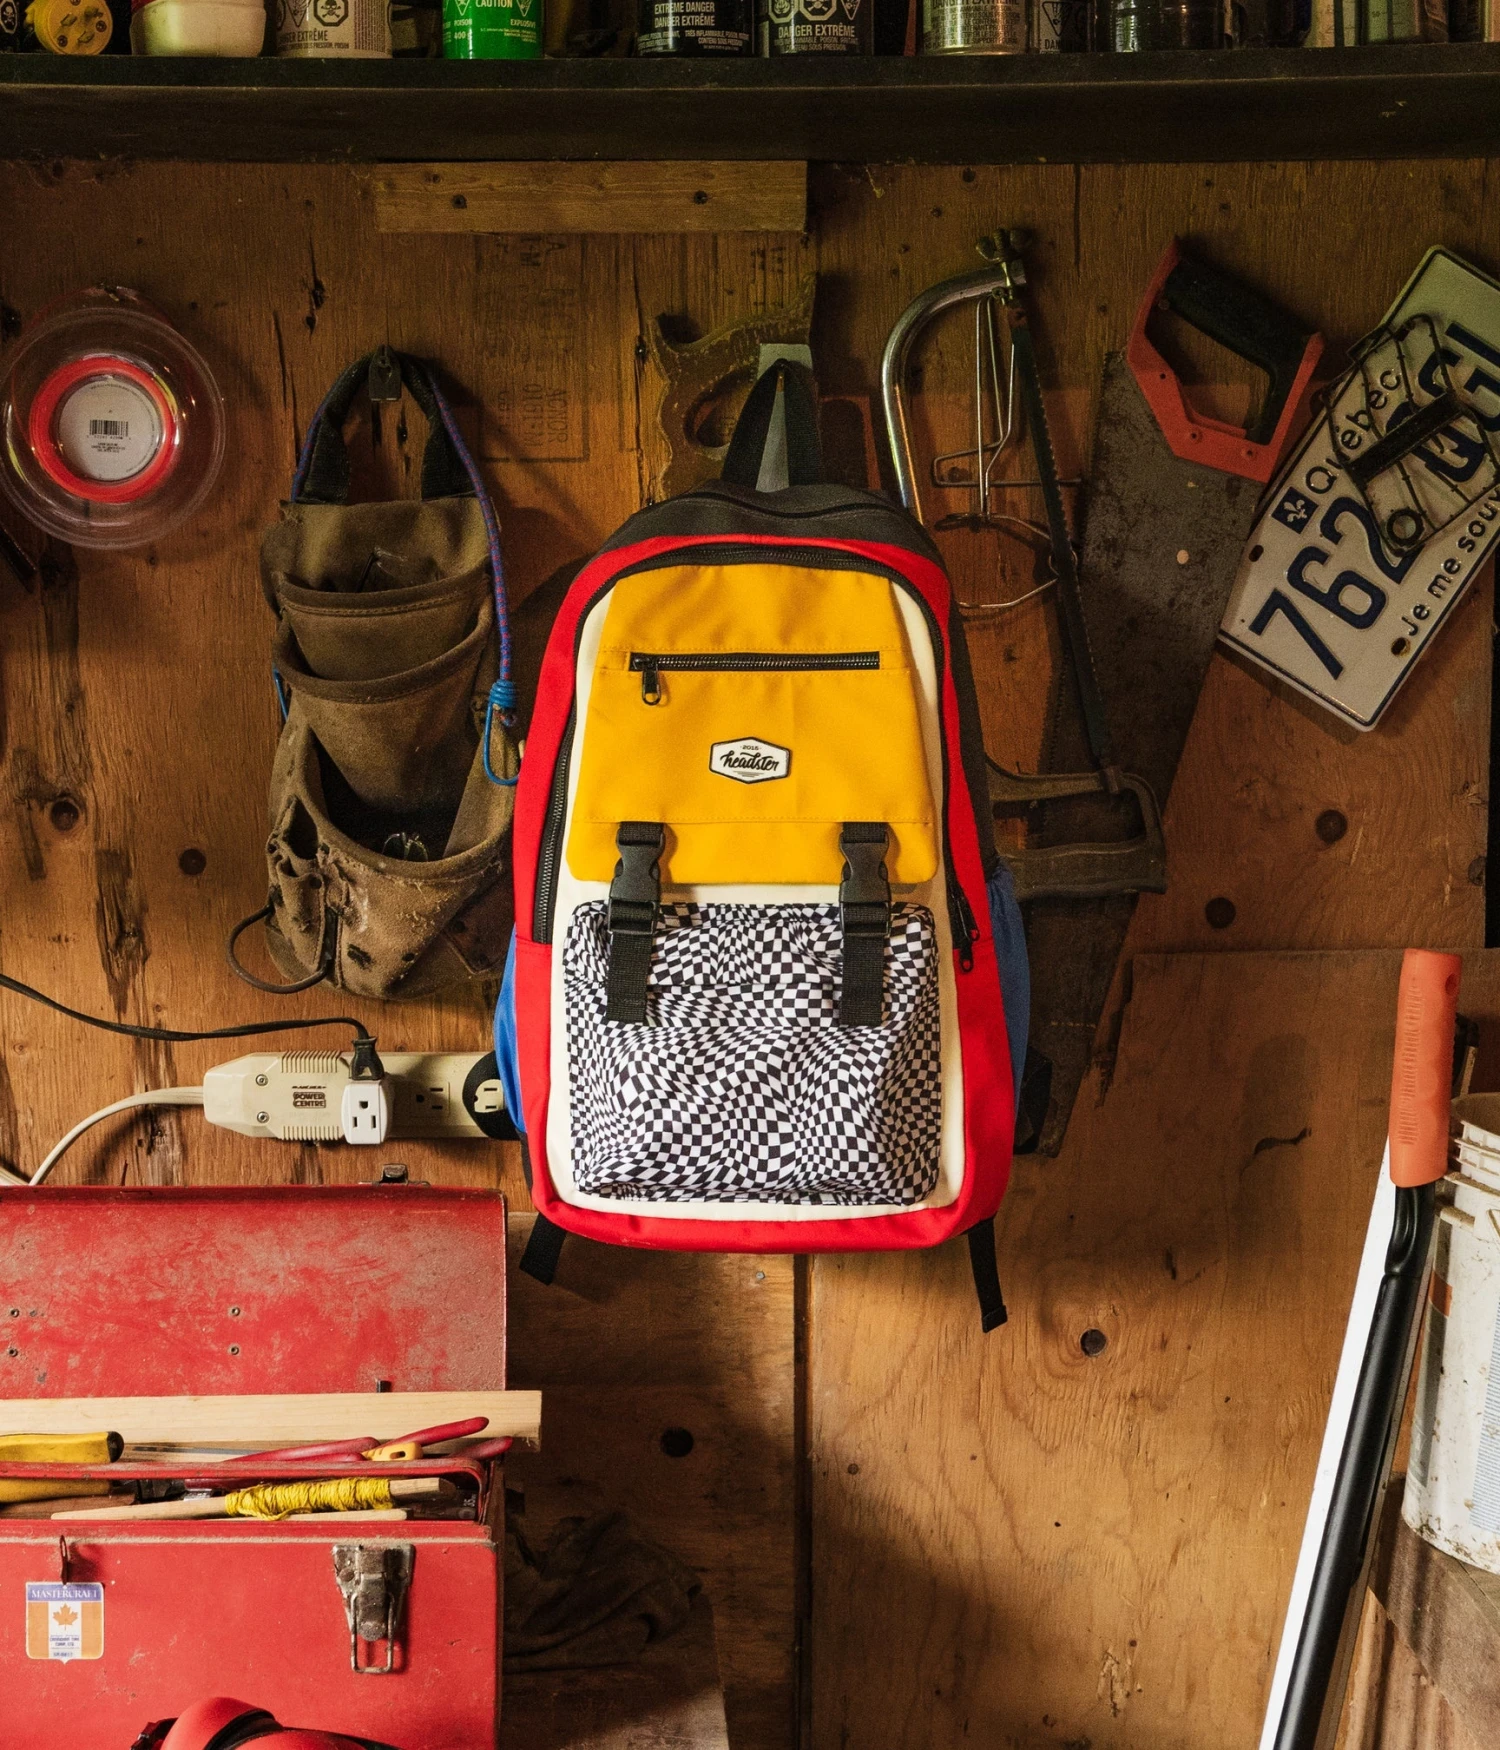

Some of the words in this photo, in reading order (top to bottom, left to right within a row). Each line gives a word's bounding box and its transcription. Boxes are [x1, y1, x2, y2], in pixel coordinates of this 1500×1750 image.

[686, 1, 715, 12] DANGER
[815, 22, 855, 37] EXTRÊME
[1305, 367, 1403, 495] Québec
[1248, 496, 1426, 681] 762
[1401, 602, 1432, 637] Je
[1427, 556, 1462, 600] me
[719, 750, 780, 772] headster
[31, 1589, 97, 1598] MASTERCRAFT
